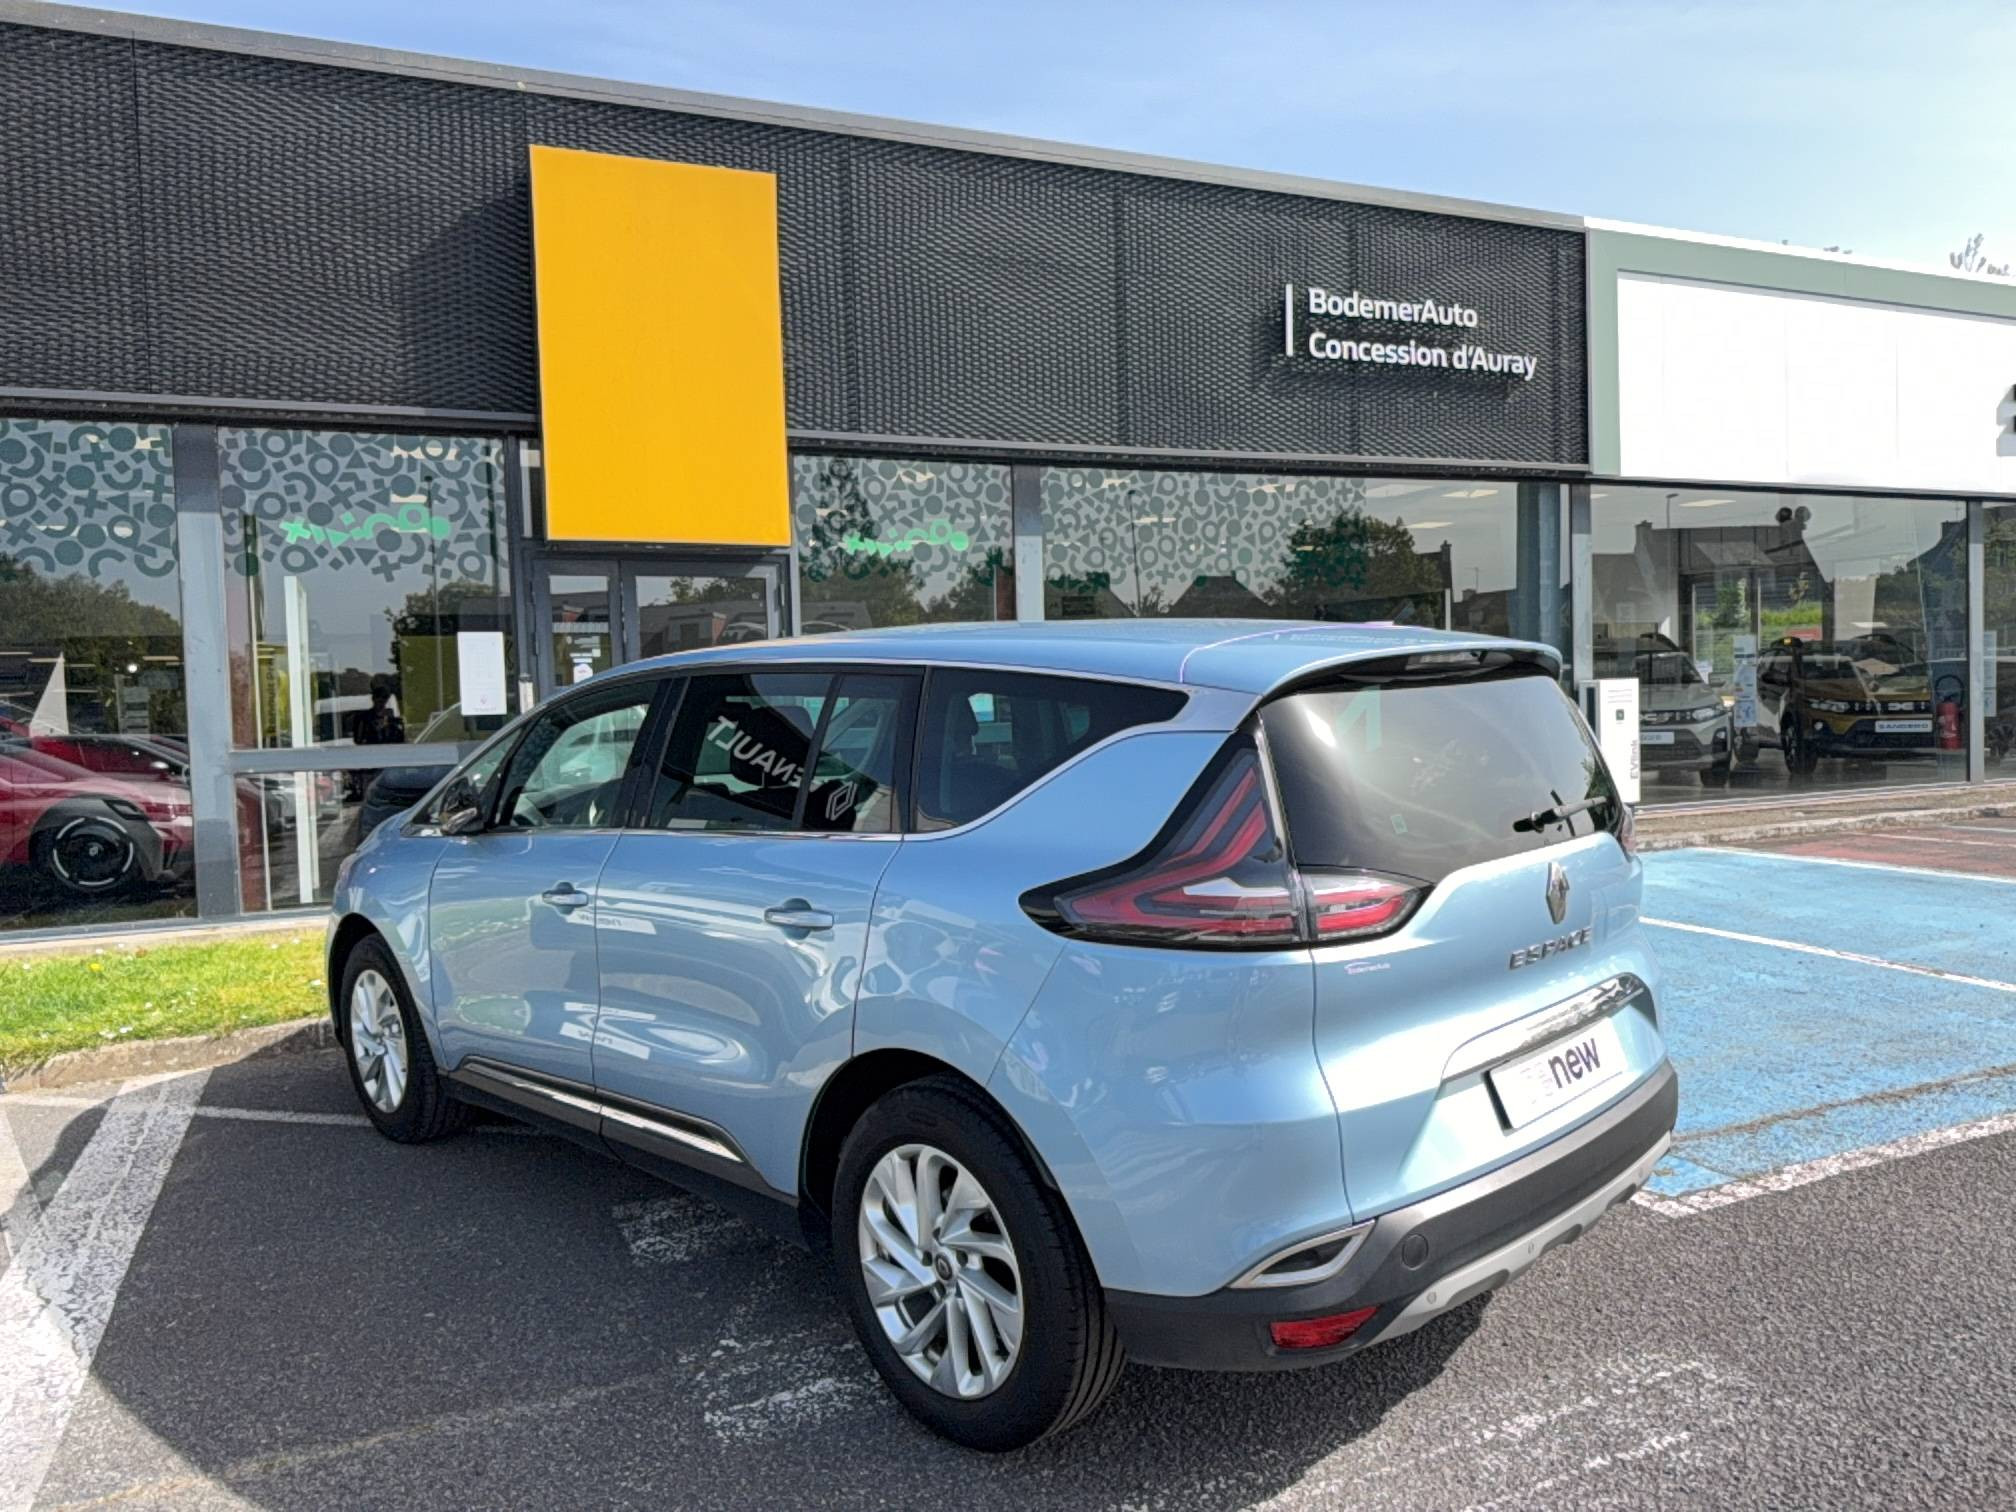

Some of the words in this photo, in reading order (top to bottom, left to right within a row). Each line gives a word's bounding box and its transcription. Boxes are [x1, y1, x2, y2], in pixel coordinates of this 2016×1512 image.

[1308, 287, 1478, 328] BodemerAuto
[1308, 331, 1449, 368] Concession
[1452, 344, 1537, 381] d'Auray
[1509, 927, 1592, 969] ESPACE
[1547, 1037, 1601, 1088] new
